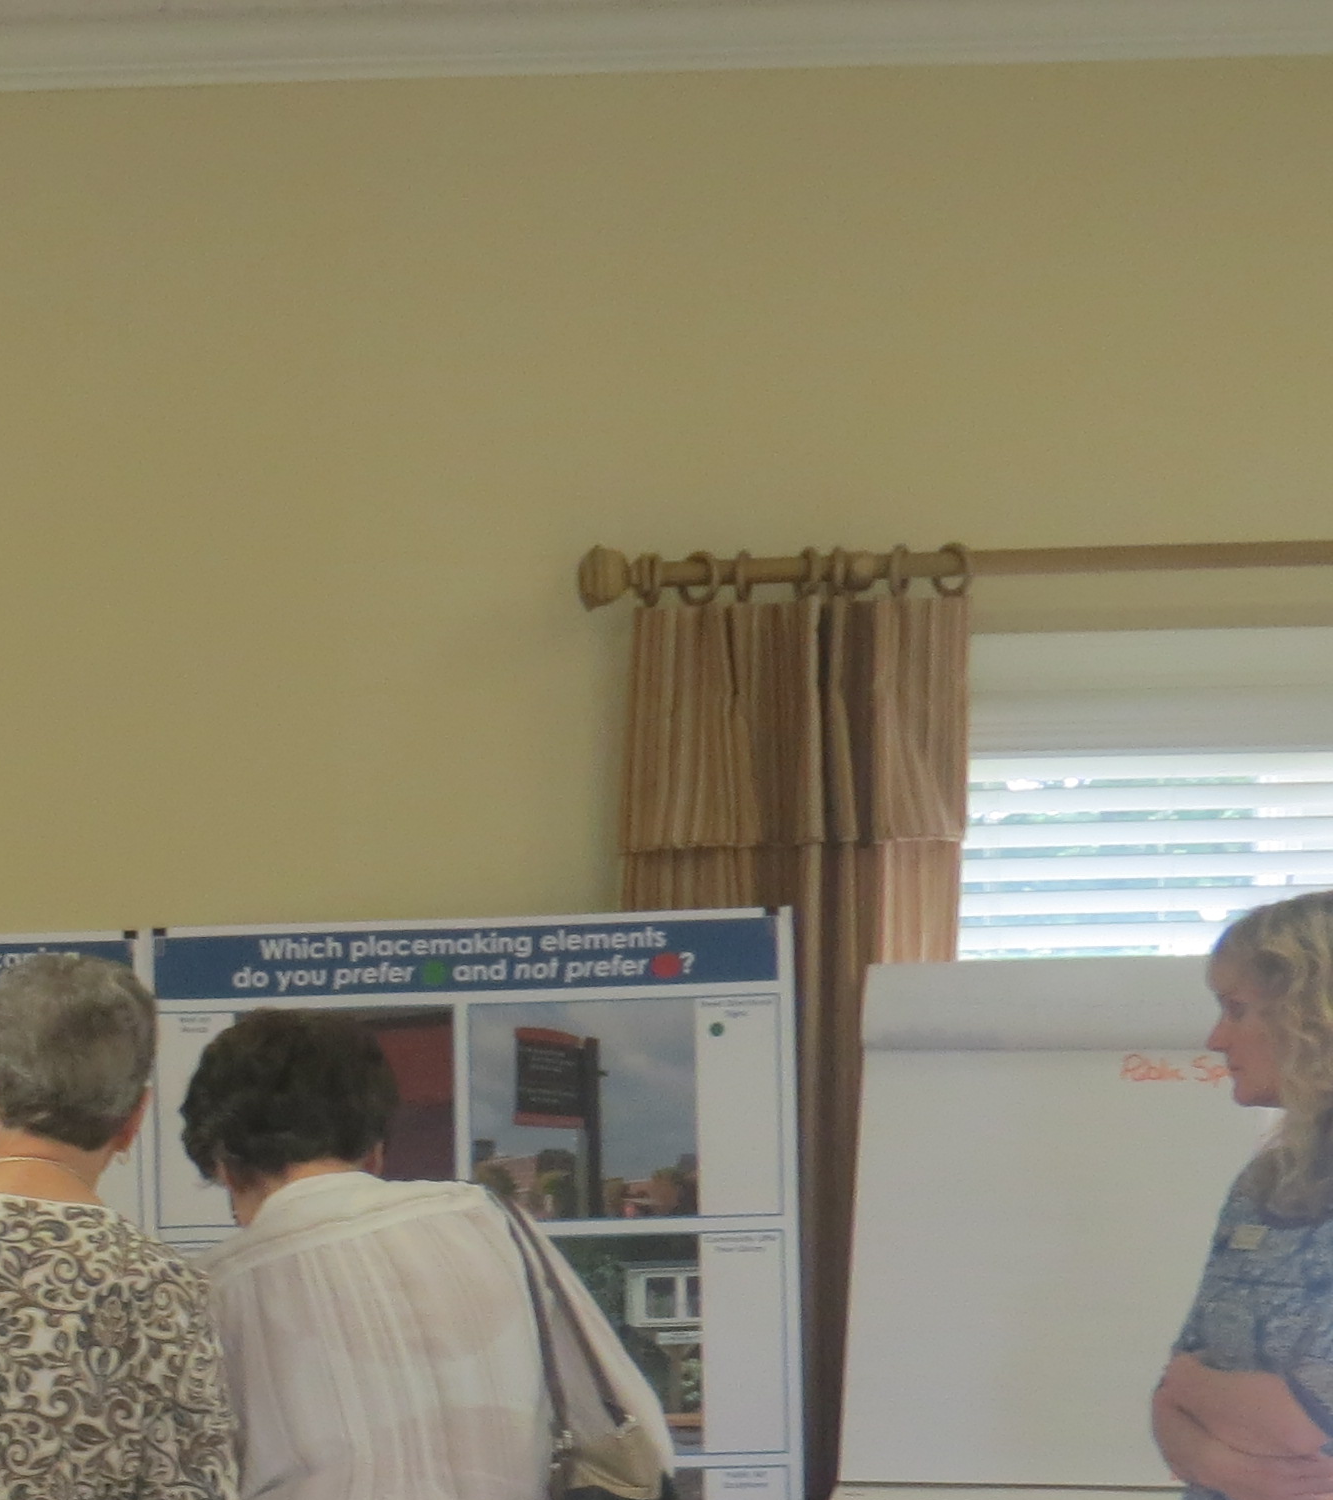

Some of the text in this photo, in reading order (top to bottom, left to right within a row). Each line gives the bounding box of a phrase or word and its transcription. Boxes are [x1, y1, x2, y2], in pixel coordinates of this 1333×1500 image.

[259, 926, 667, 962] Which placemaking elements
[233, 966, 269, 988] do
[276, 969, 328, 992] you
[333, 961, 416, 990] prefer
[453, 958, 508, 982] and
[514, 956, 559, 980] not
[564, 954, 650, 983] prefer
